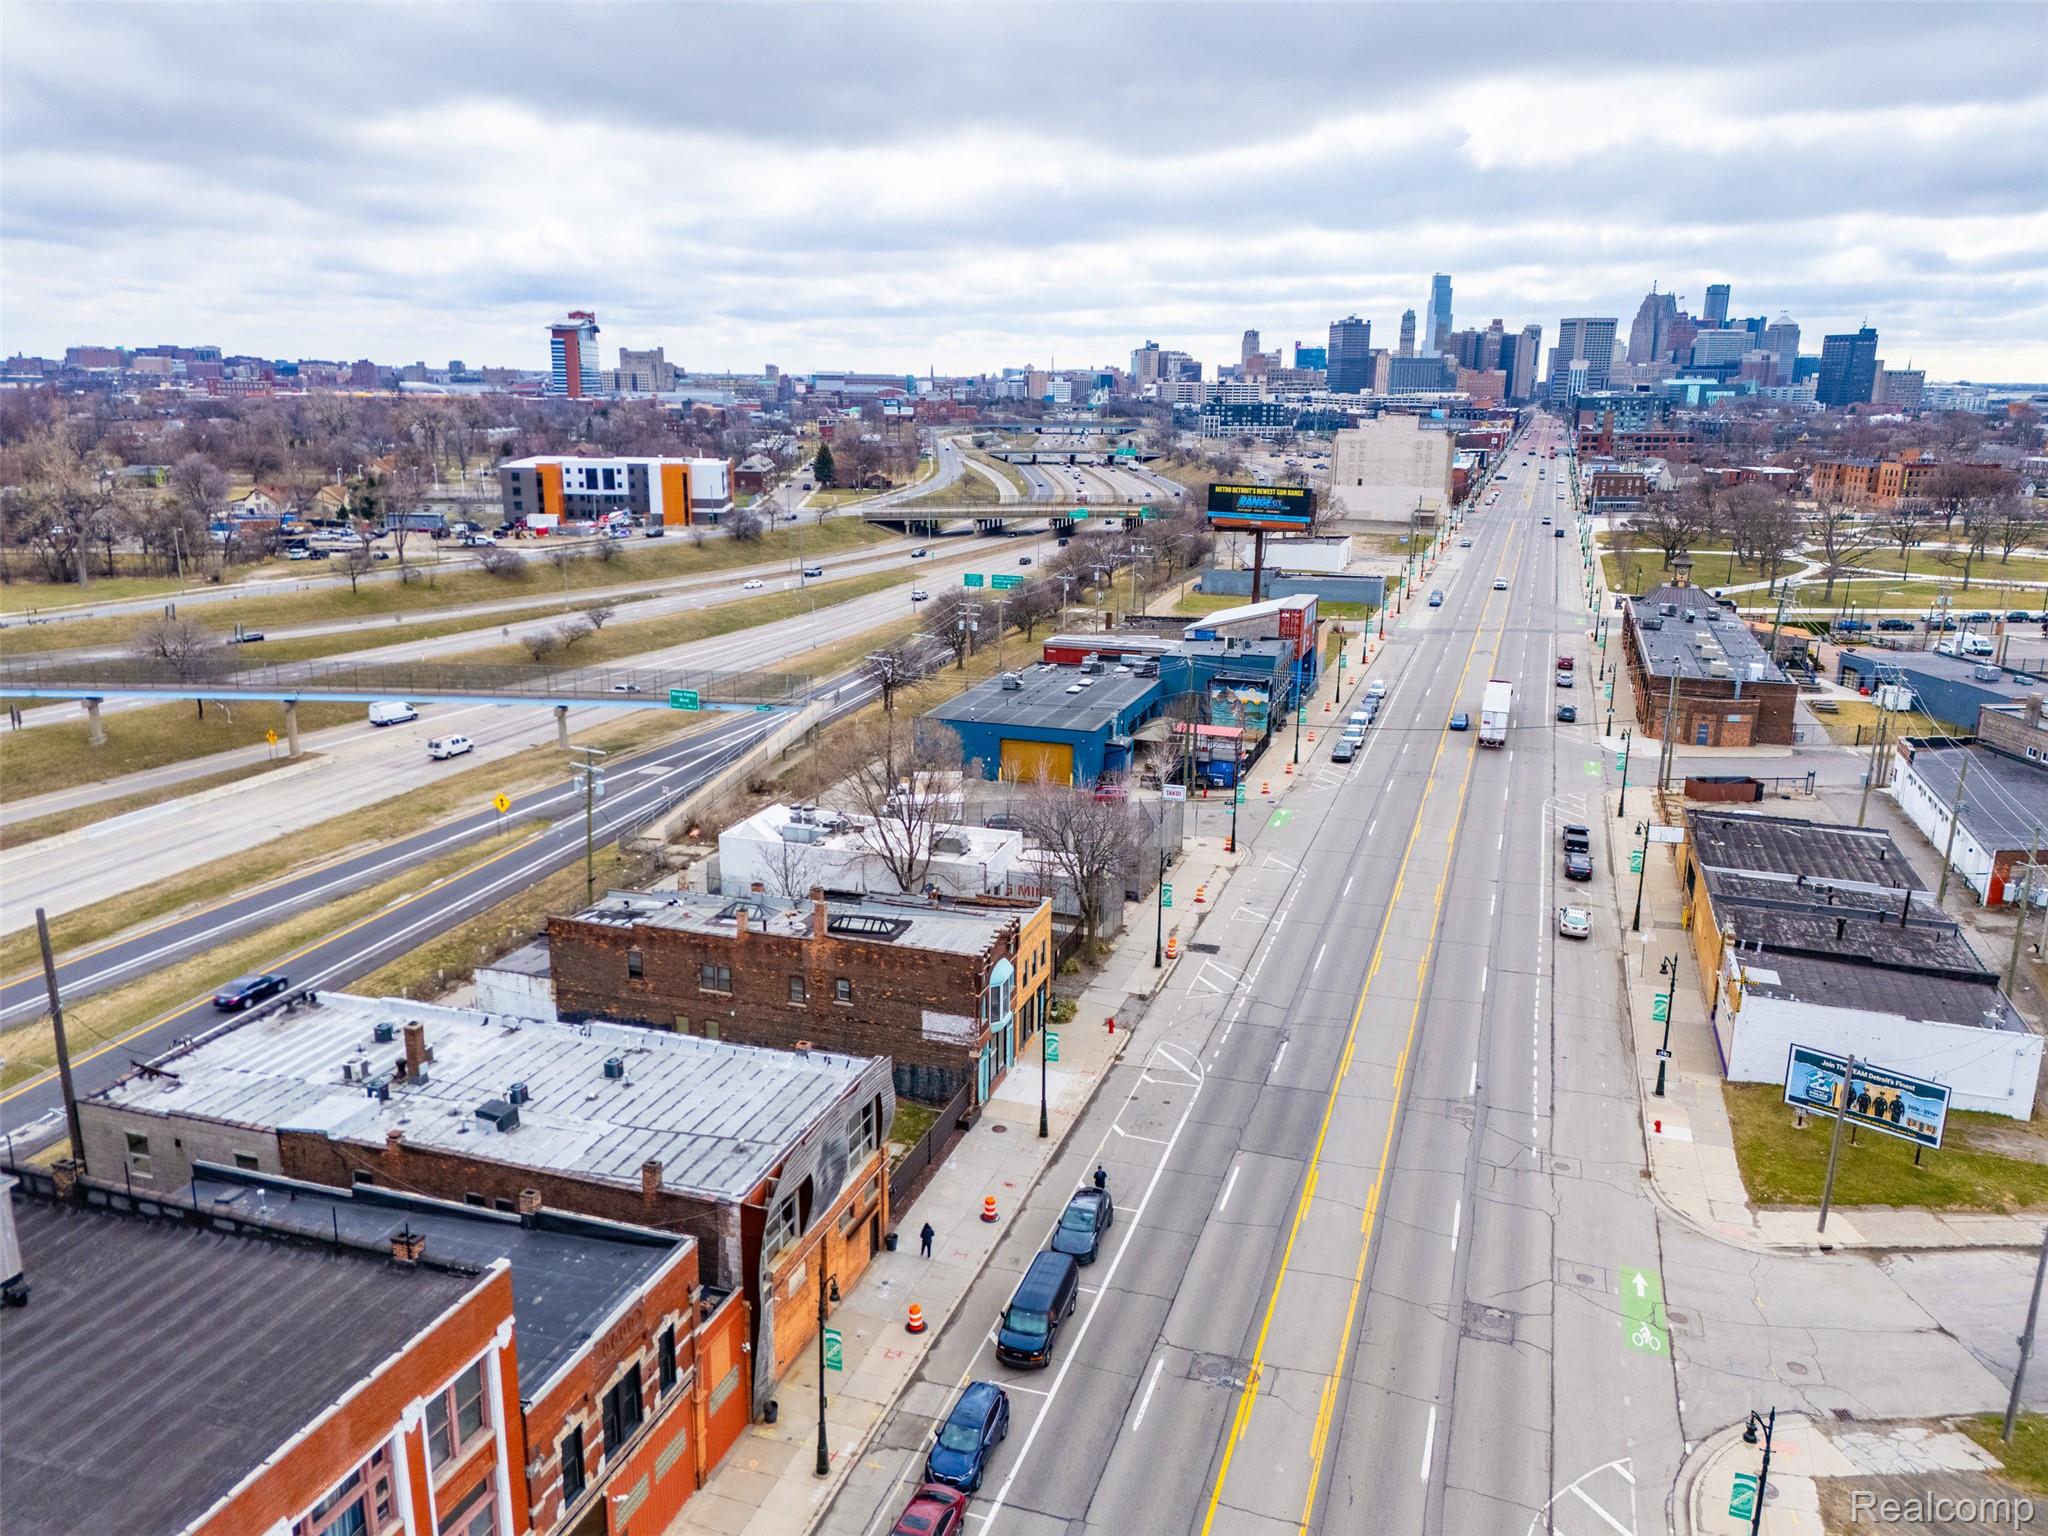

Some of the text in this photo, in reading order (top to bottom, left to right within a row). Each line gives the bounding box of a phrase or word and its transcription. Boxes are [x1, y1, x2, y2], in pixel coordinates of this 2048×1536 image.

[1287, 489, 1304, 497] RANGE
[1821, 1060, 1836, 1069] Join
[1852, 1068, 1868, 1078] EAM
[1868, 1072, 1895, 1085] Detroit's
[1895, 1080, 1916, 1091] Finest
